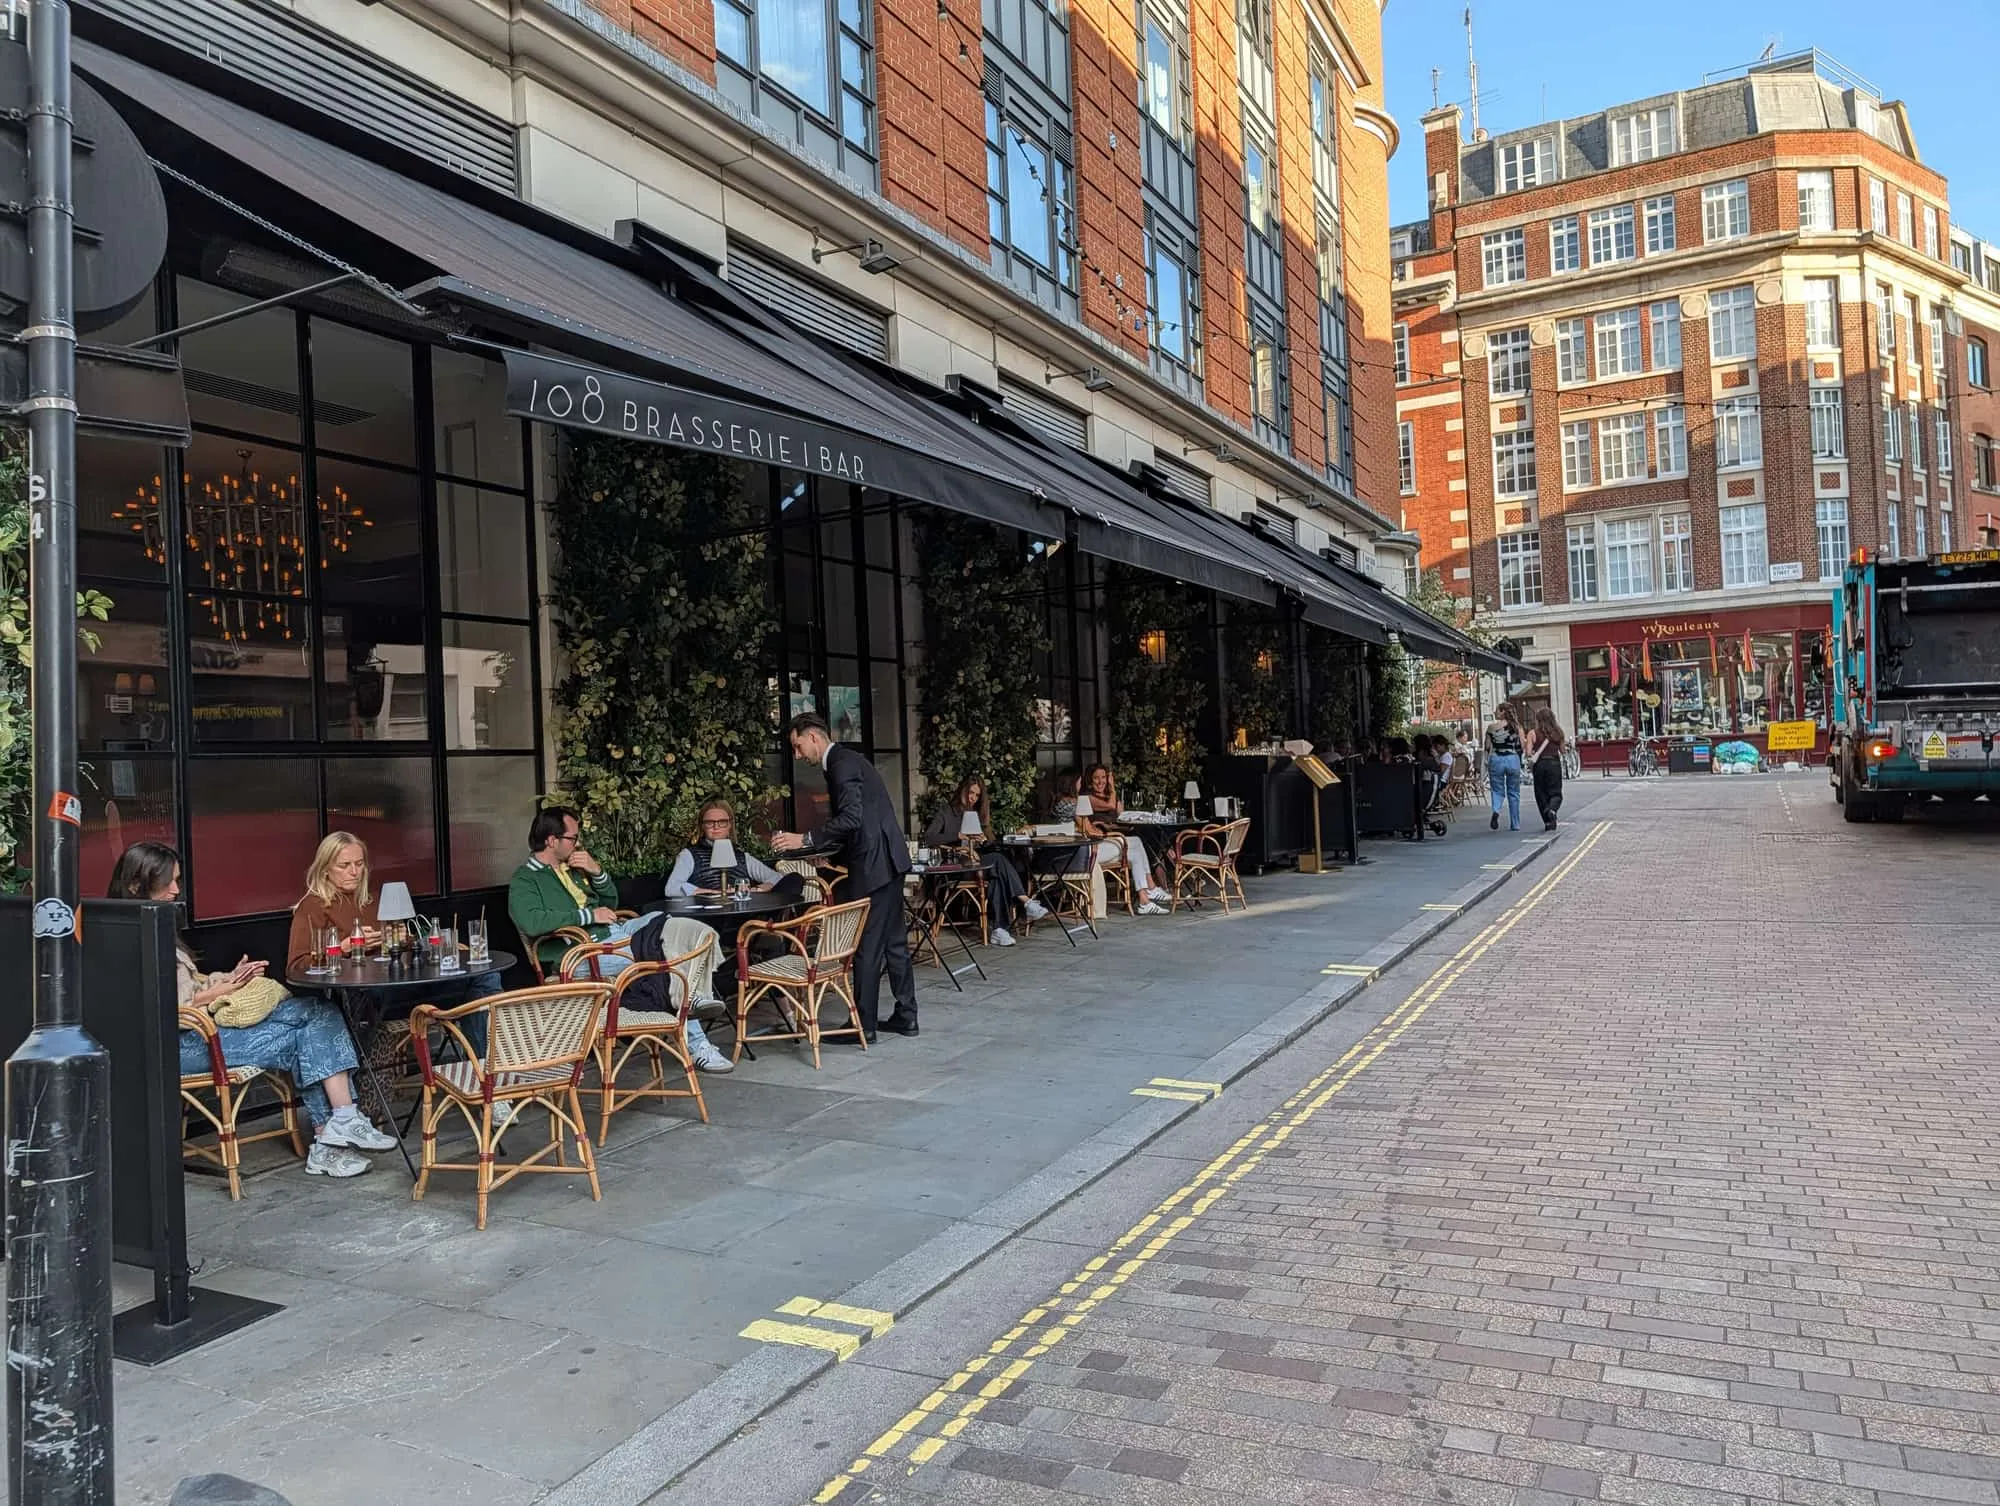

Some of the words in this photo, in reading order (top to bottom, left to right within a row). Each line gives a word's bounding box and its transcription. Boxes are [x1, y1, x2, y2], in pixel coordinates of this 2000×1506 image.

[529, 375, 605, 424] 108
[623, 400, 793, 464] BRASSERIE
[820, 446, 866, 481] BAR
